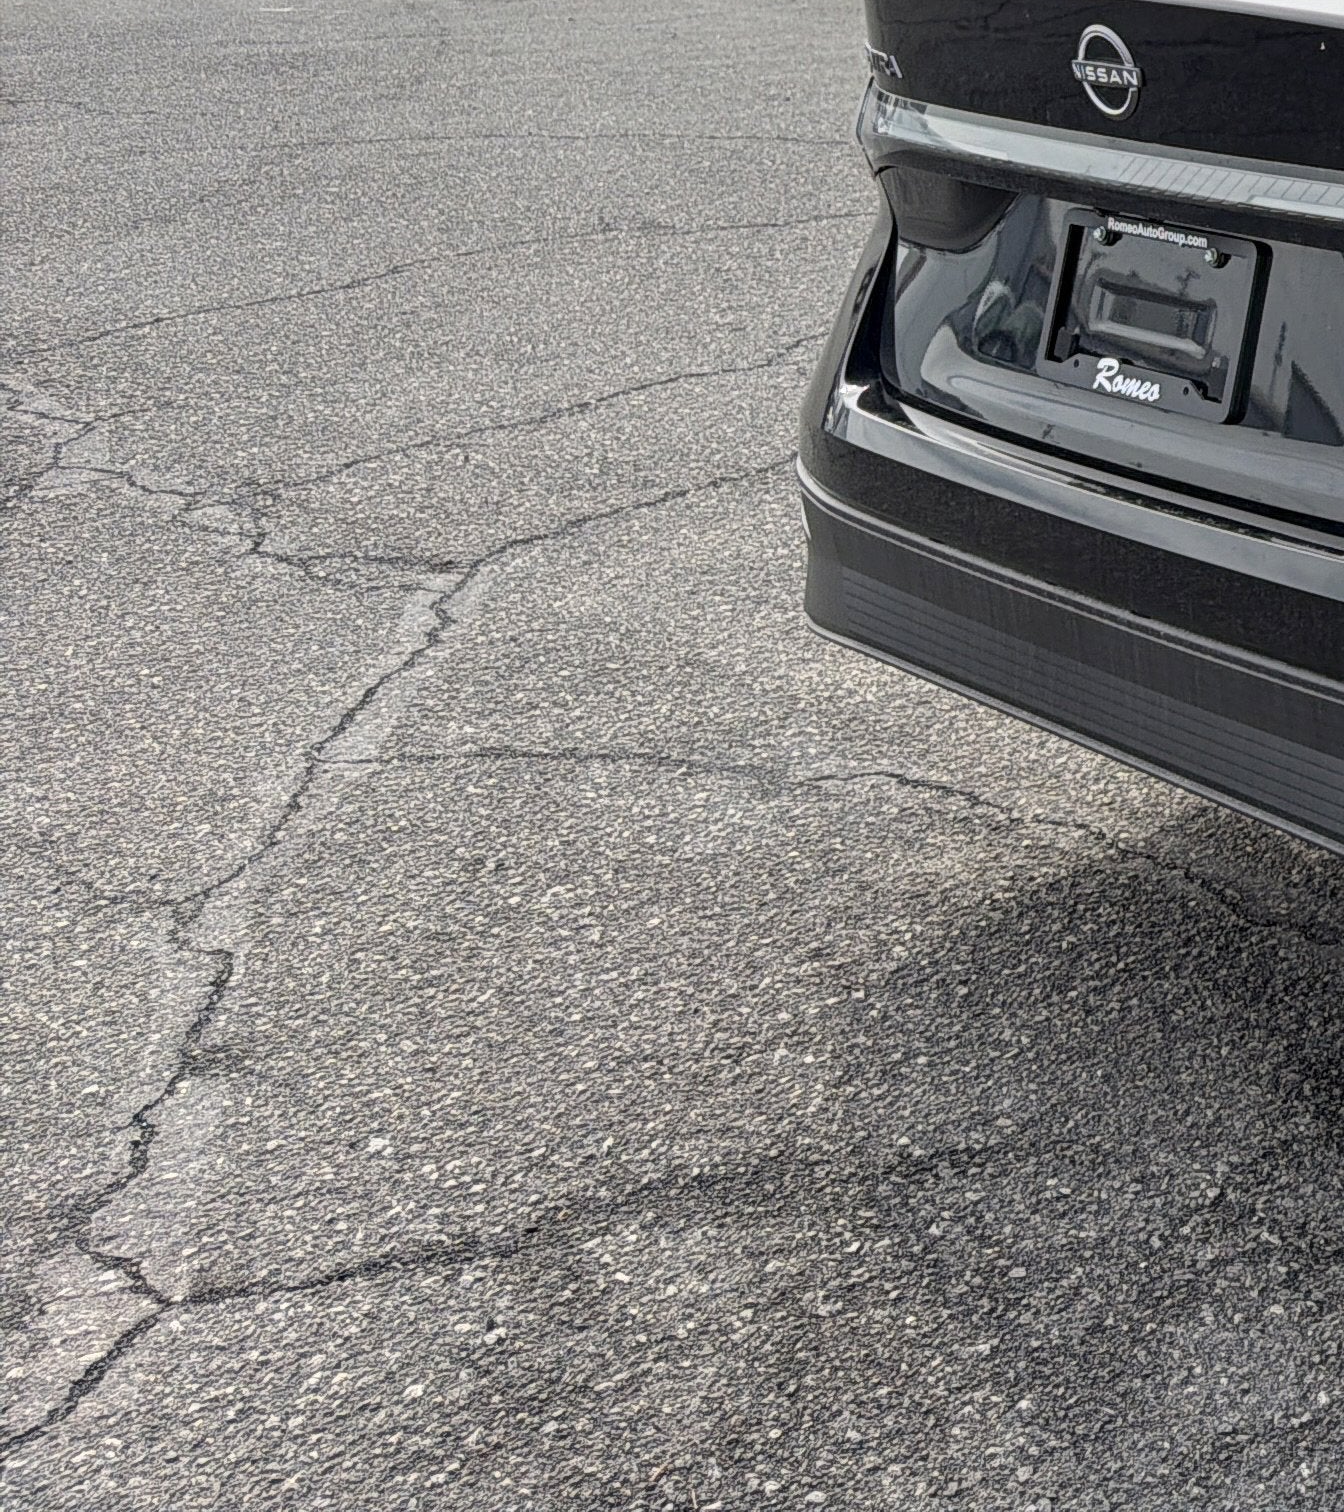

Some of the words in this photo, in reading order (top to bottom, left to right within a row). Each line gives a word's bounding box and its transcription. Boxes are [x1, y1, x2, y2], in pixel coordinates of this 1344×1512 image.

[1072, 63, 1138, 86] NISSAN
[1107, 216, 1208, 248] RomeoAutoGroup.com
[1092, 357, 1161, 402] Romeo
